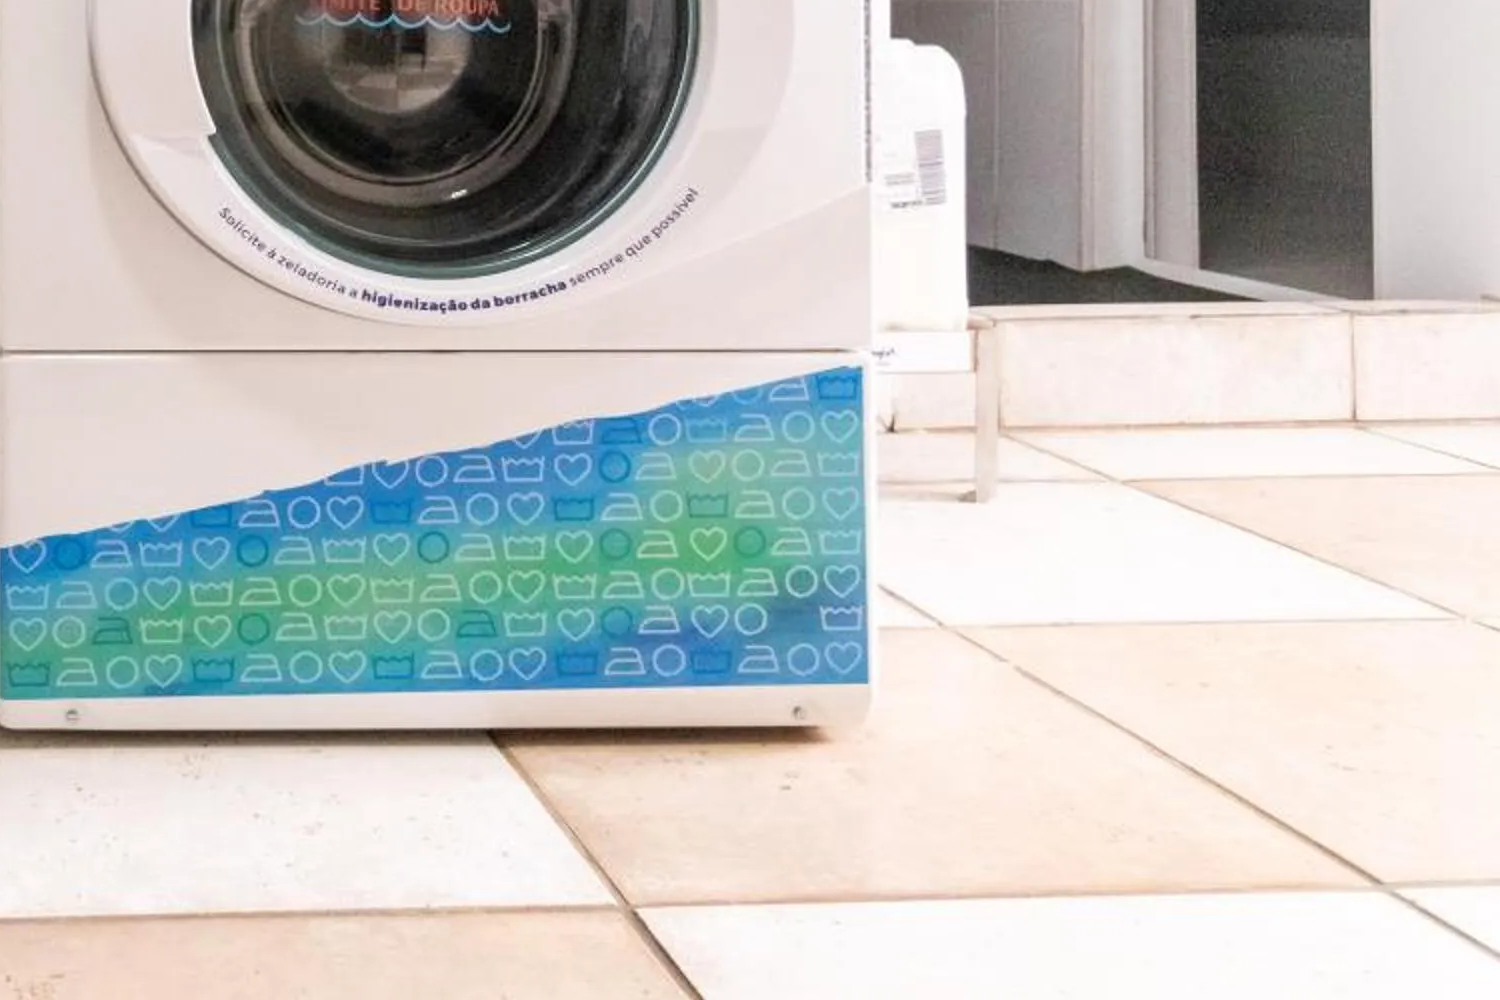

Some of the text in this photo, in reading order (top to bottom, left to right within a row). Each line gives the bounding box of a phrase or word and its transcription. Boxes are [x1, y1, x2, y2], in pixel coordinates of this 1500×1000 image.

[219, 206, 267, 252] Solicite
[277, 255, 345, 294] zeladoria
[361, 289, 468, 314] higienização
[470, 296, 491, 311] da
[493, 281, 568, 307] borracha
[569, 252, 625, 287] sempre
[624, 235, 653, 259] que
